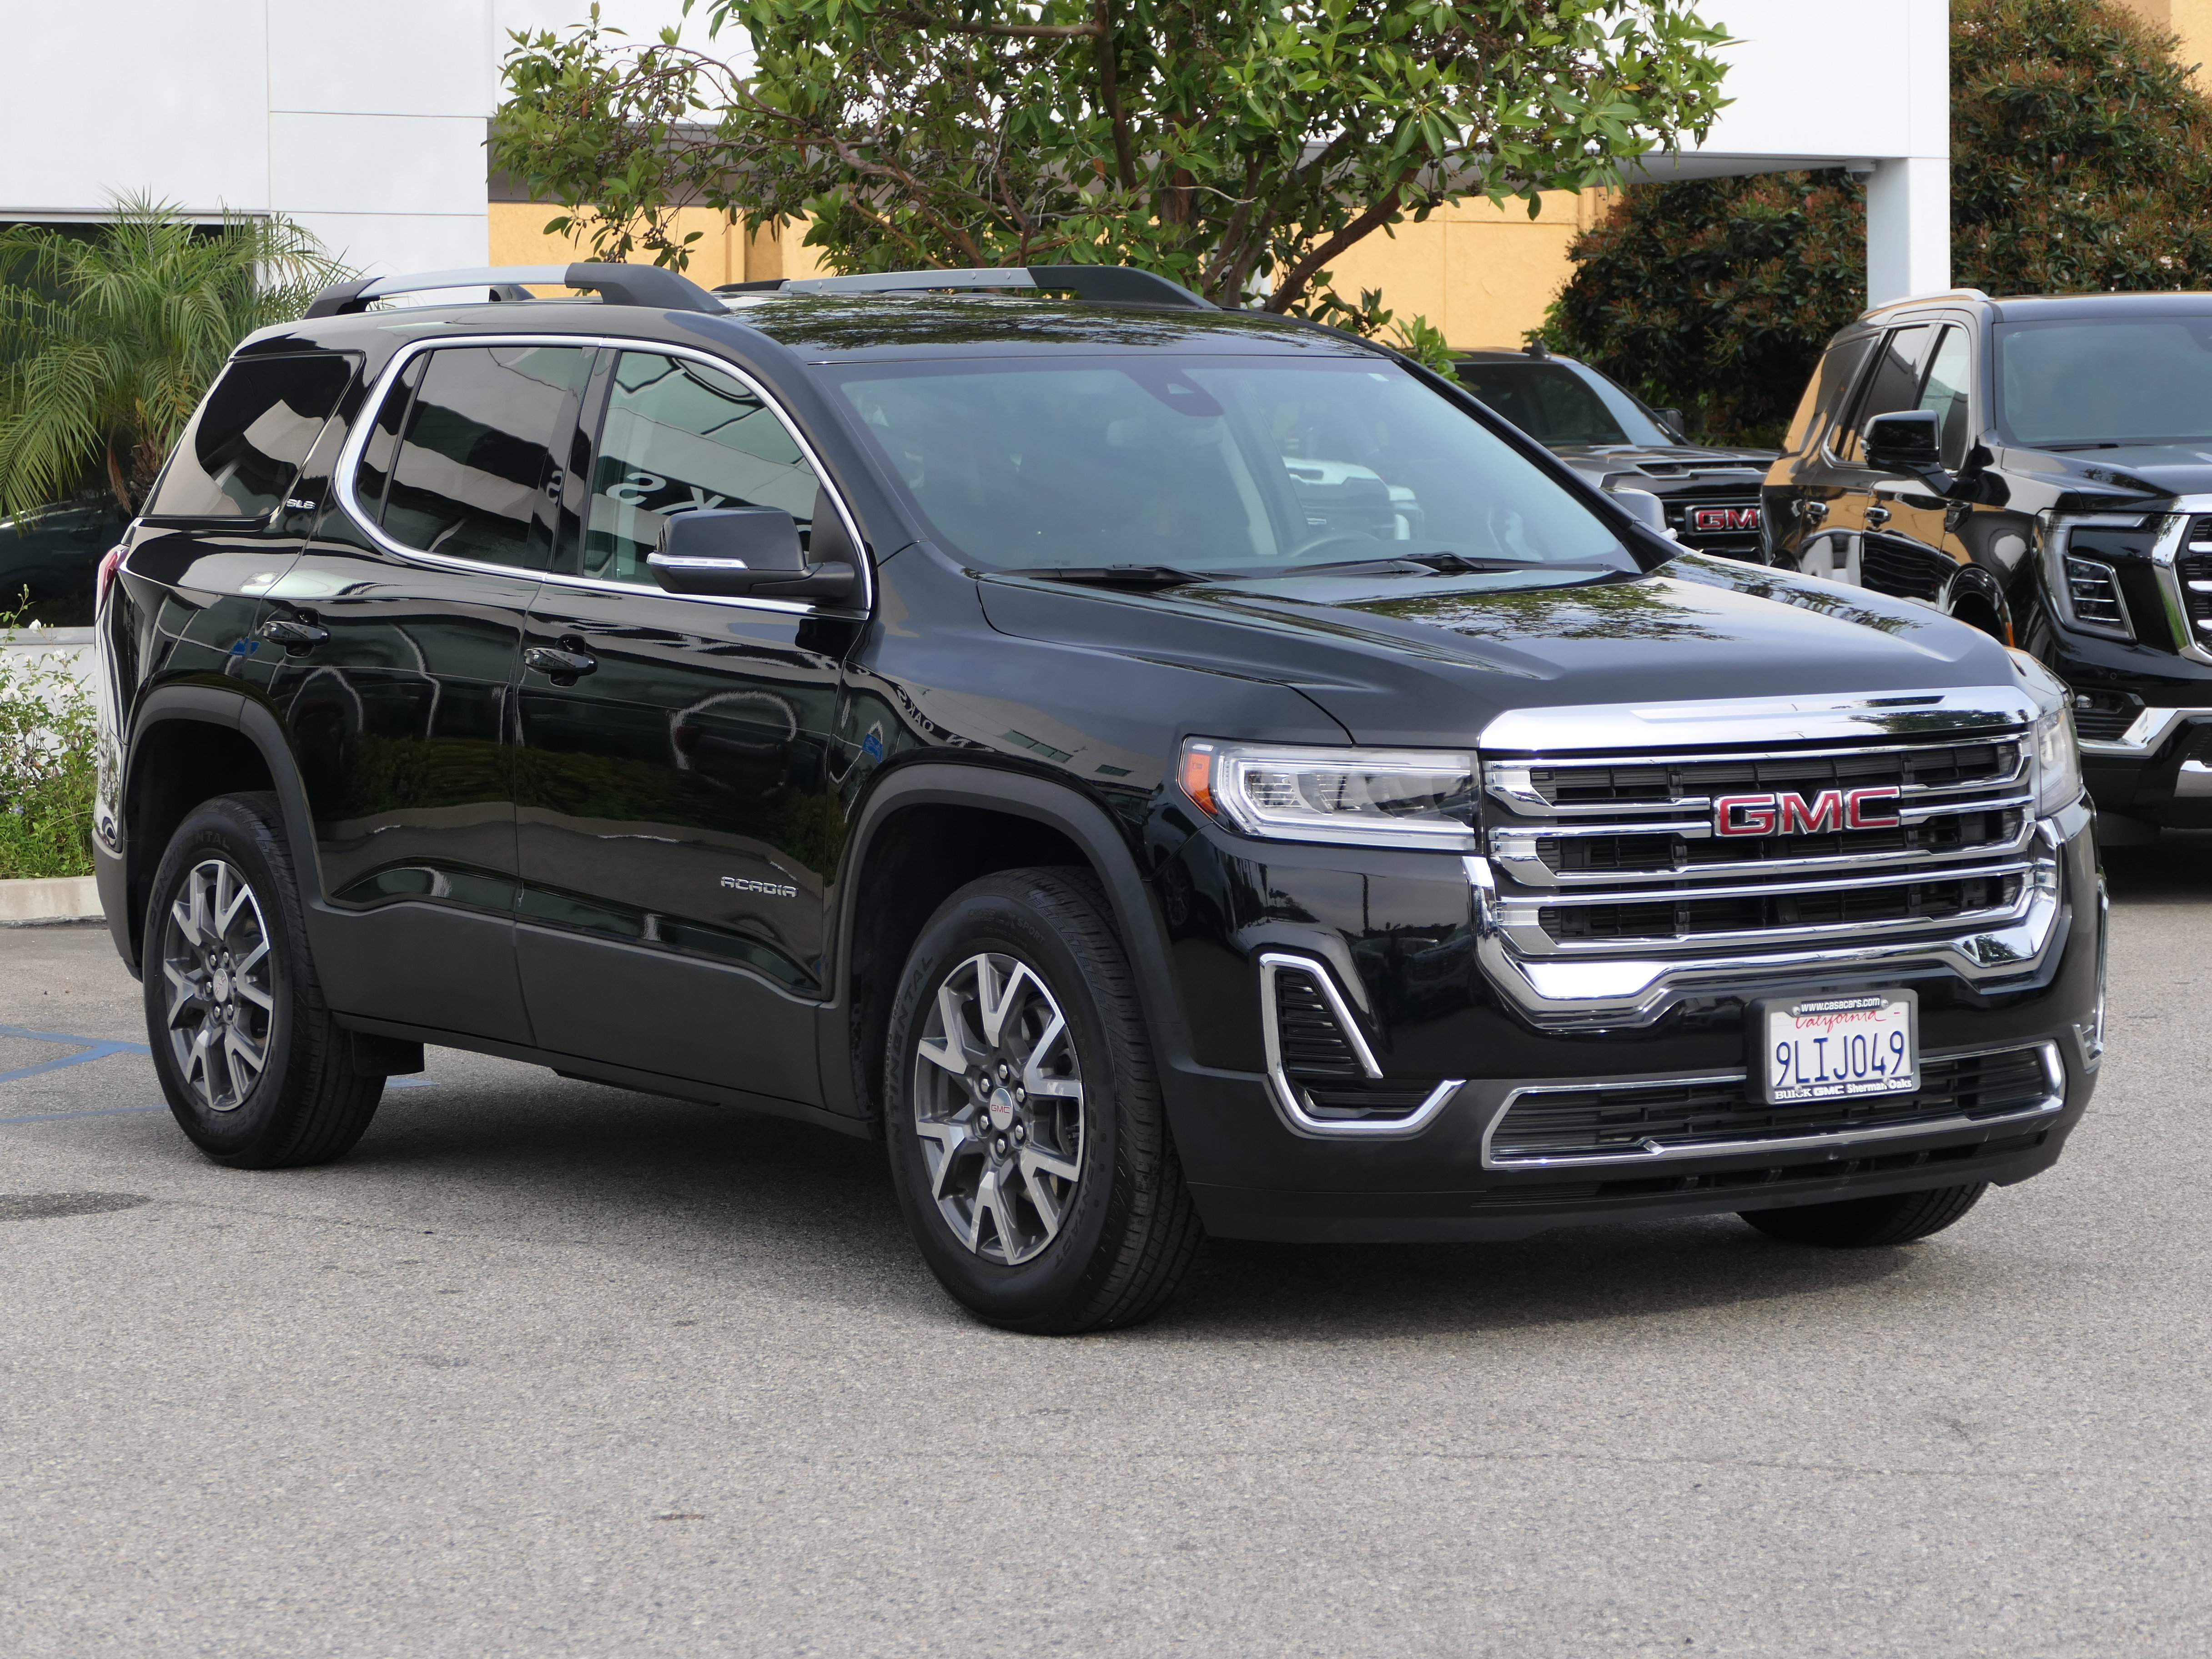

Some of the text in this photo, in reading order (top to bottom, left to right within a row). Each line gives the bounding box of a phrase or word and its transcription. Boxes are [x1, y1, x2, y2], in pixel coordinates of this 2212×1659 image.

[286, 499, 316, 509] SLE
[1695, 508, 1760, 531] GM
[1713, 786, 1900, 837] GMC
[721, 876, 798, 898] ACADIA
[1016, 918, 1046, 944] SPORT
[1801, 997, 1880, 1012] www.casacars.com
[1796, 1010, 1887, 1033] California
[1776, 1030, 1905, 1086] 9LIJ049
[1814, 1086, 1845, 1096] GMC
[1847, 1082, 1887, 1093] Sherman
[1889, 1079, 1912, 1089] Oaks
[991, 1104, 1010, 1114] GMC
